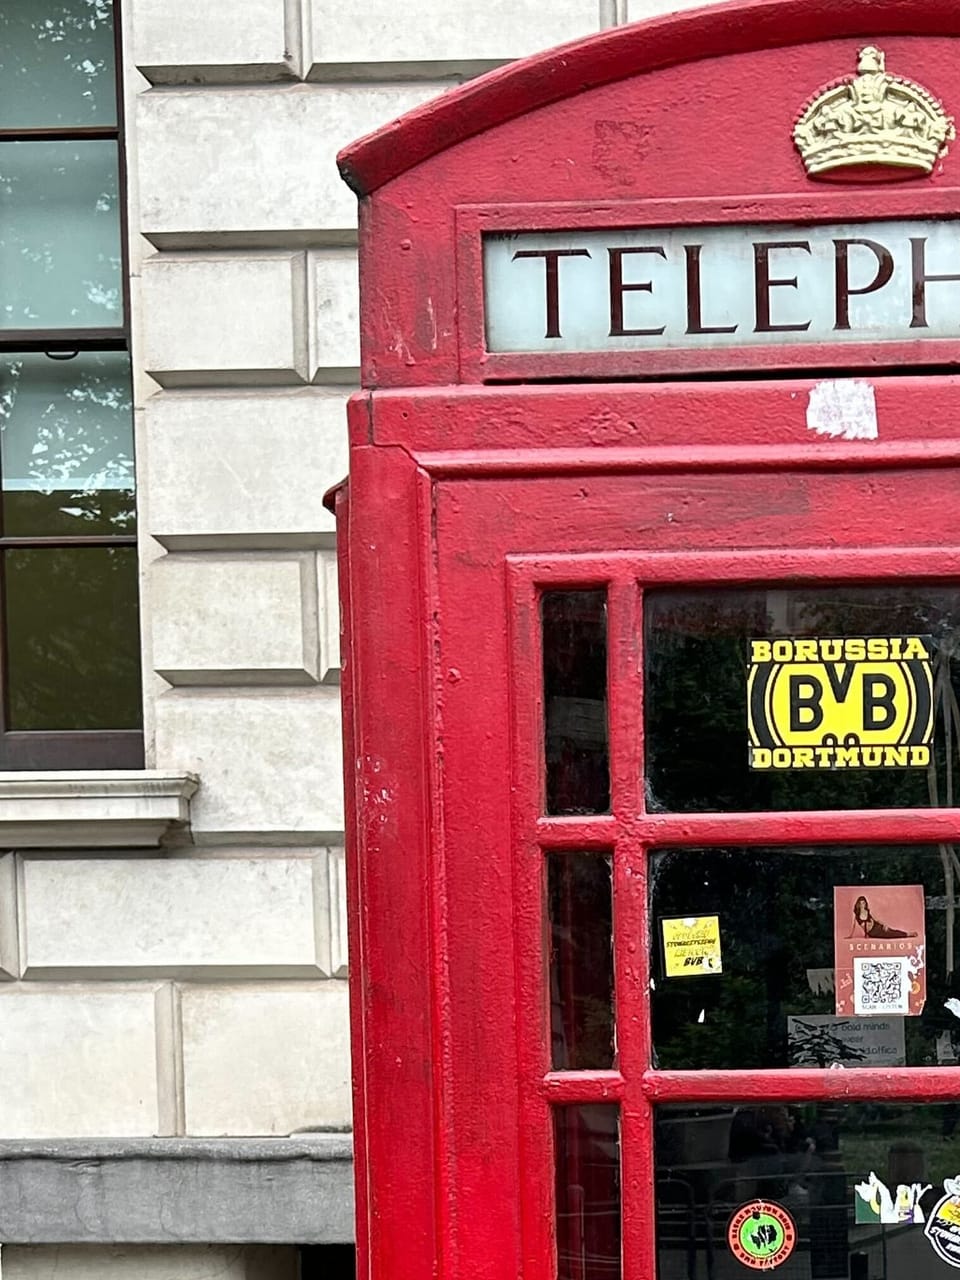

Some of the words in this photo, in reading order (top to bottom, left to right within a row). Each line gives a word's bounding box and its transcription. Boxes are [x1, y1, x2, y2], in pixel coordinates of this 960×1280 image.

[751, 637, 930, 663] BORUSSIA
[789, 663, 897, 732] BVB
[752, 745, 930, 769] DORTMUND
